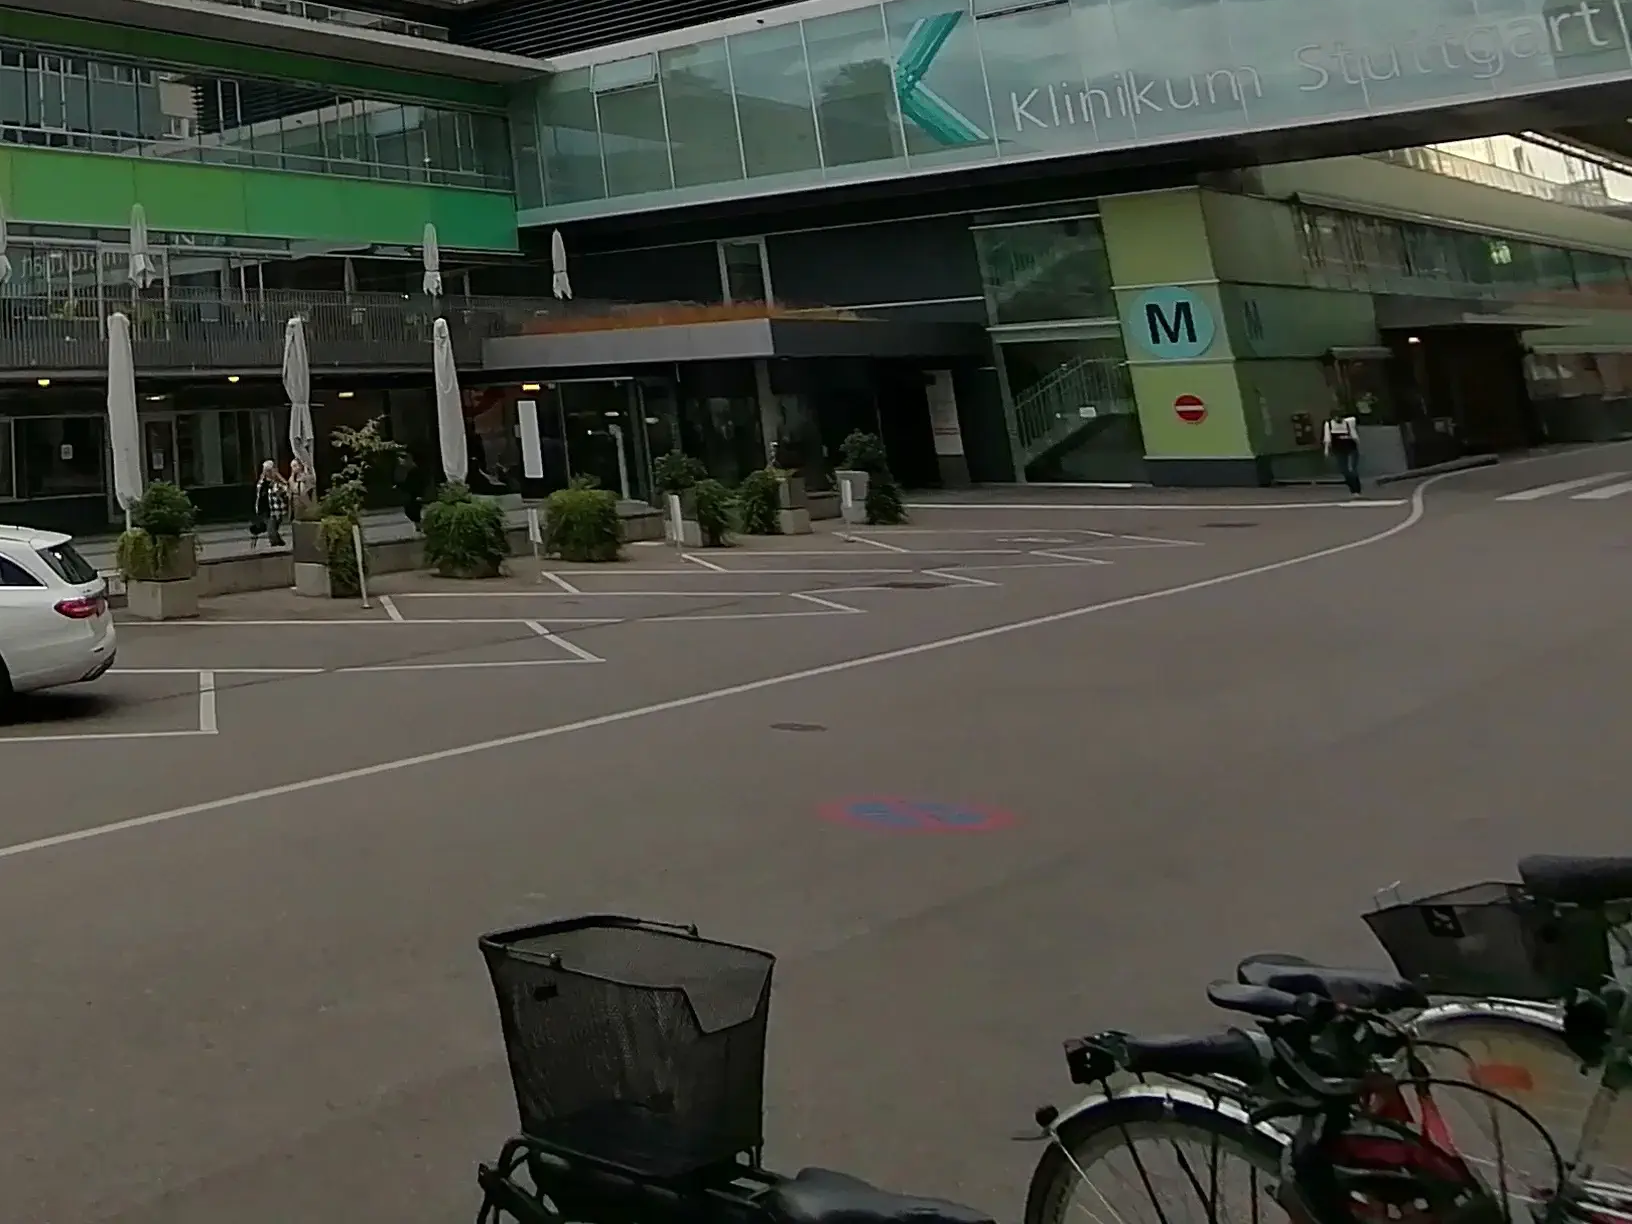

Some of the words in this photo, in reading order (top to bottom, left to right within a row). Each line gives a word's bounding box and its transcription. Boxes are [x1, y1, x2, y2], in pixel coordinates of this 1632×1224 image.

[1010, 64, 1263, 132] Klinikum
[1292, 0, 1609, 92] Stuttgart
[1145, 301, 1197, 344] M
